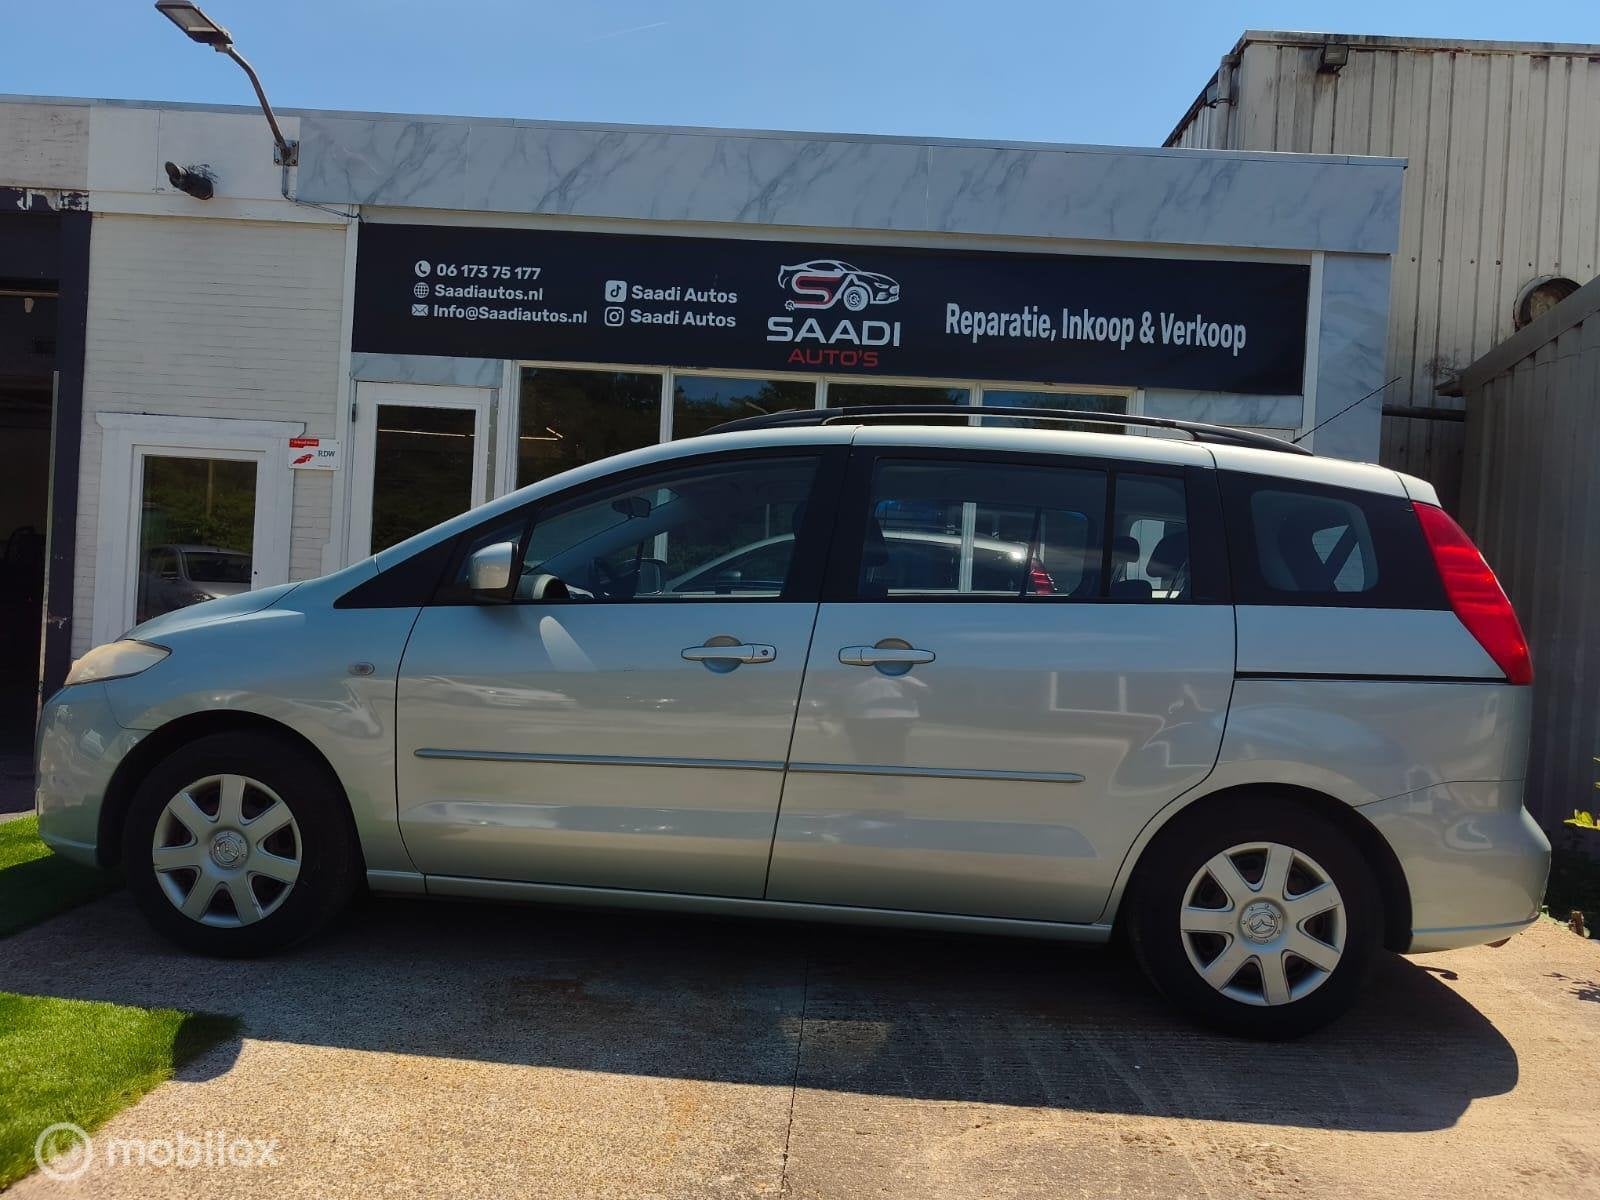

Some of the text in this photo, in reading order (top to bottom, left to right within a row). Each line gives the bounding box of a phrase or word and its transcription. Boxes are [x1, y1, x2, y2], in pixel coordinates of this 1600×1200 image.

[437, 264, 541, 280] 06 173 75 177
[435, 284, 542, 301] Saadiautos.nl
[631, 285, 738, 303] Saadi Autos
[433, 304, 588, 324] Info@Saadiautos.nl
[630, 309, 737, 327] Saadi Autos
[766, 316, 901, 347] SAADI
[946, 303, 1247, 357] Reparatie, Inkoop & Verkoop
[788, 349, 879, 367] AUTO'S
